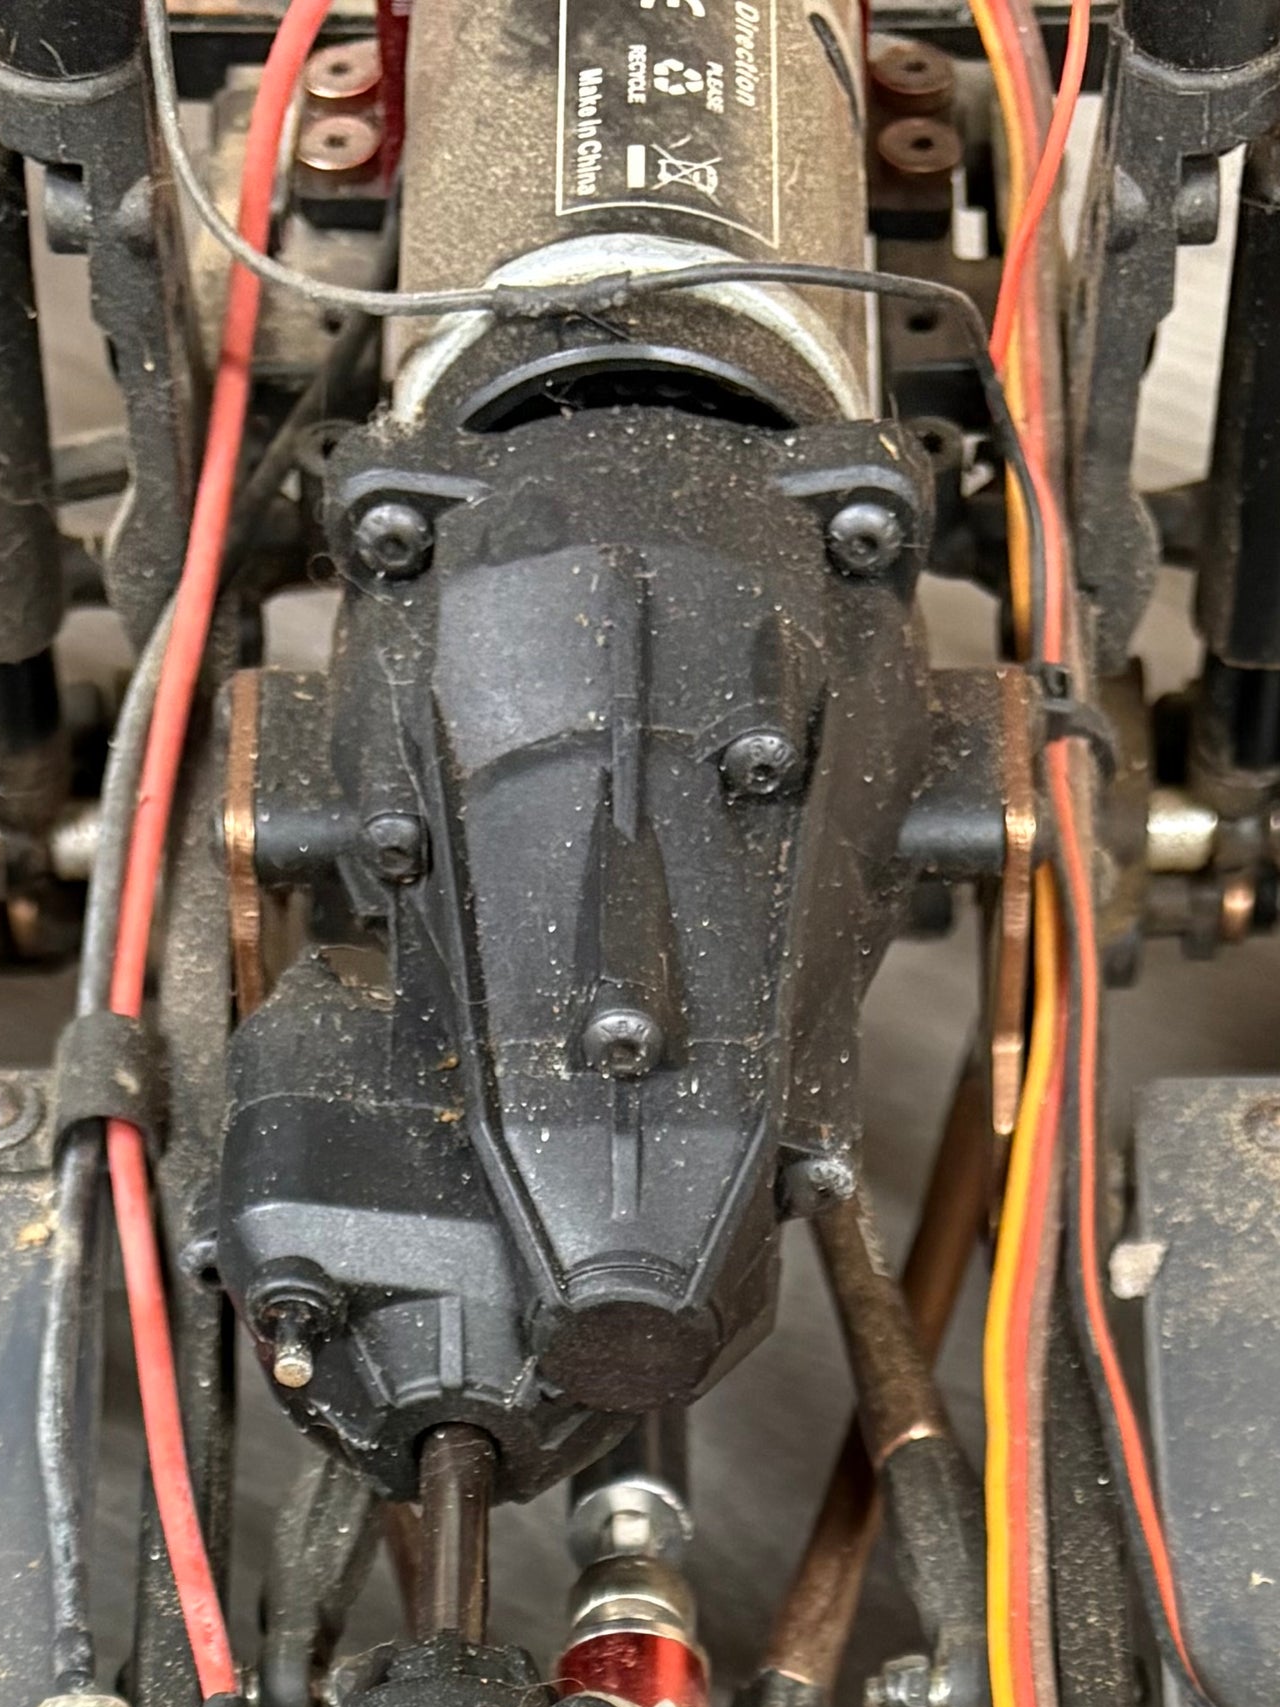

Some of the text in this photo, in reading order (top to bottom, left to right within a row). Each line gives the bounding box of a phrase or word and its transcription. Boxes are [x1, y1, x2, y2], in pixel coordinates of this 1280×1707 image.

[627, 45, 647, 104] RECYCLE
[734, 1, 760, 107] Direction
[706, 61, 724, 114] PLEASE
